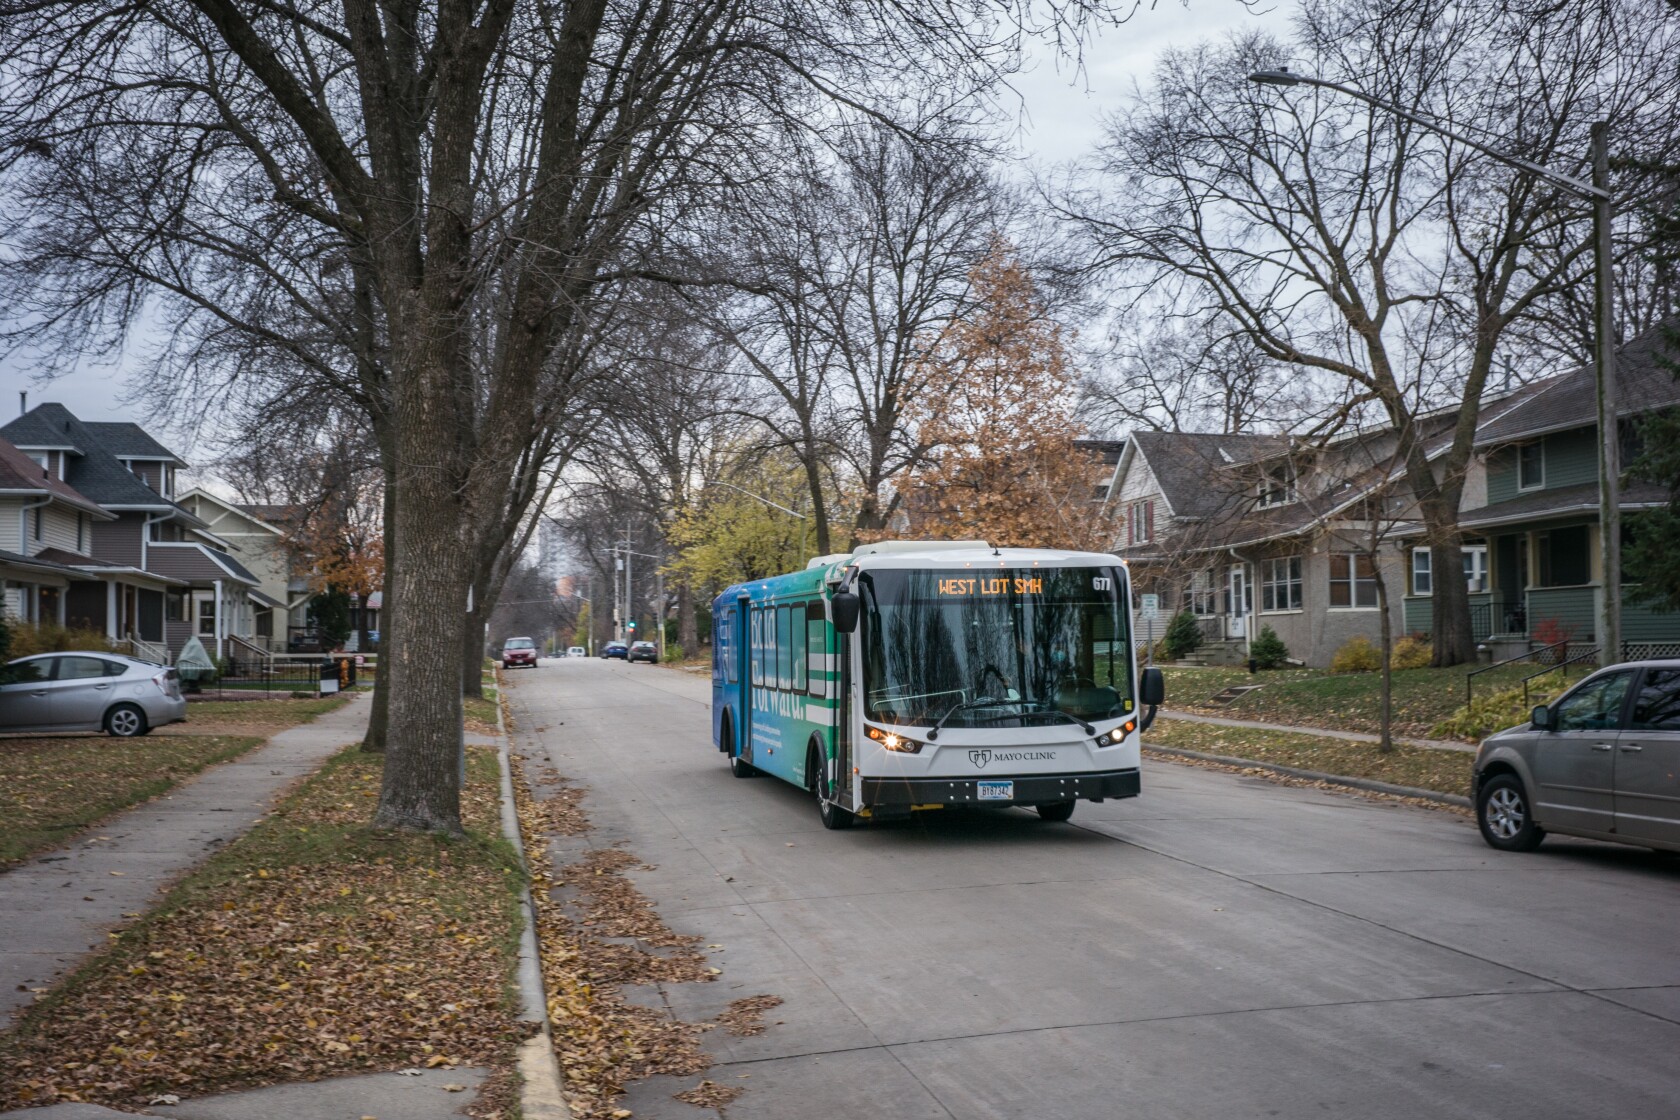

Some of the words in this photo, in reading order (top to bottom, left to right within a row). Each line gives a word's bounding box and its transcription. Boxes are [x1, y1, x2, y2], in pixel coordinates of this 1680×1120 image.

[939, 579, 976, 595] WEST
[981, 578, 1009, 594] LOT
[1014, 578, 1042, 594] SMH
[1092, 576, 1111, 591] 677
[994, 753, 1022, 761] MAYO
[1023, 752, 1056, 760] CLINIC
